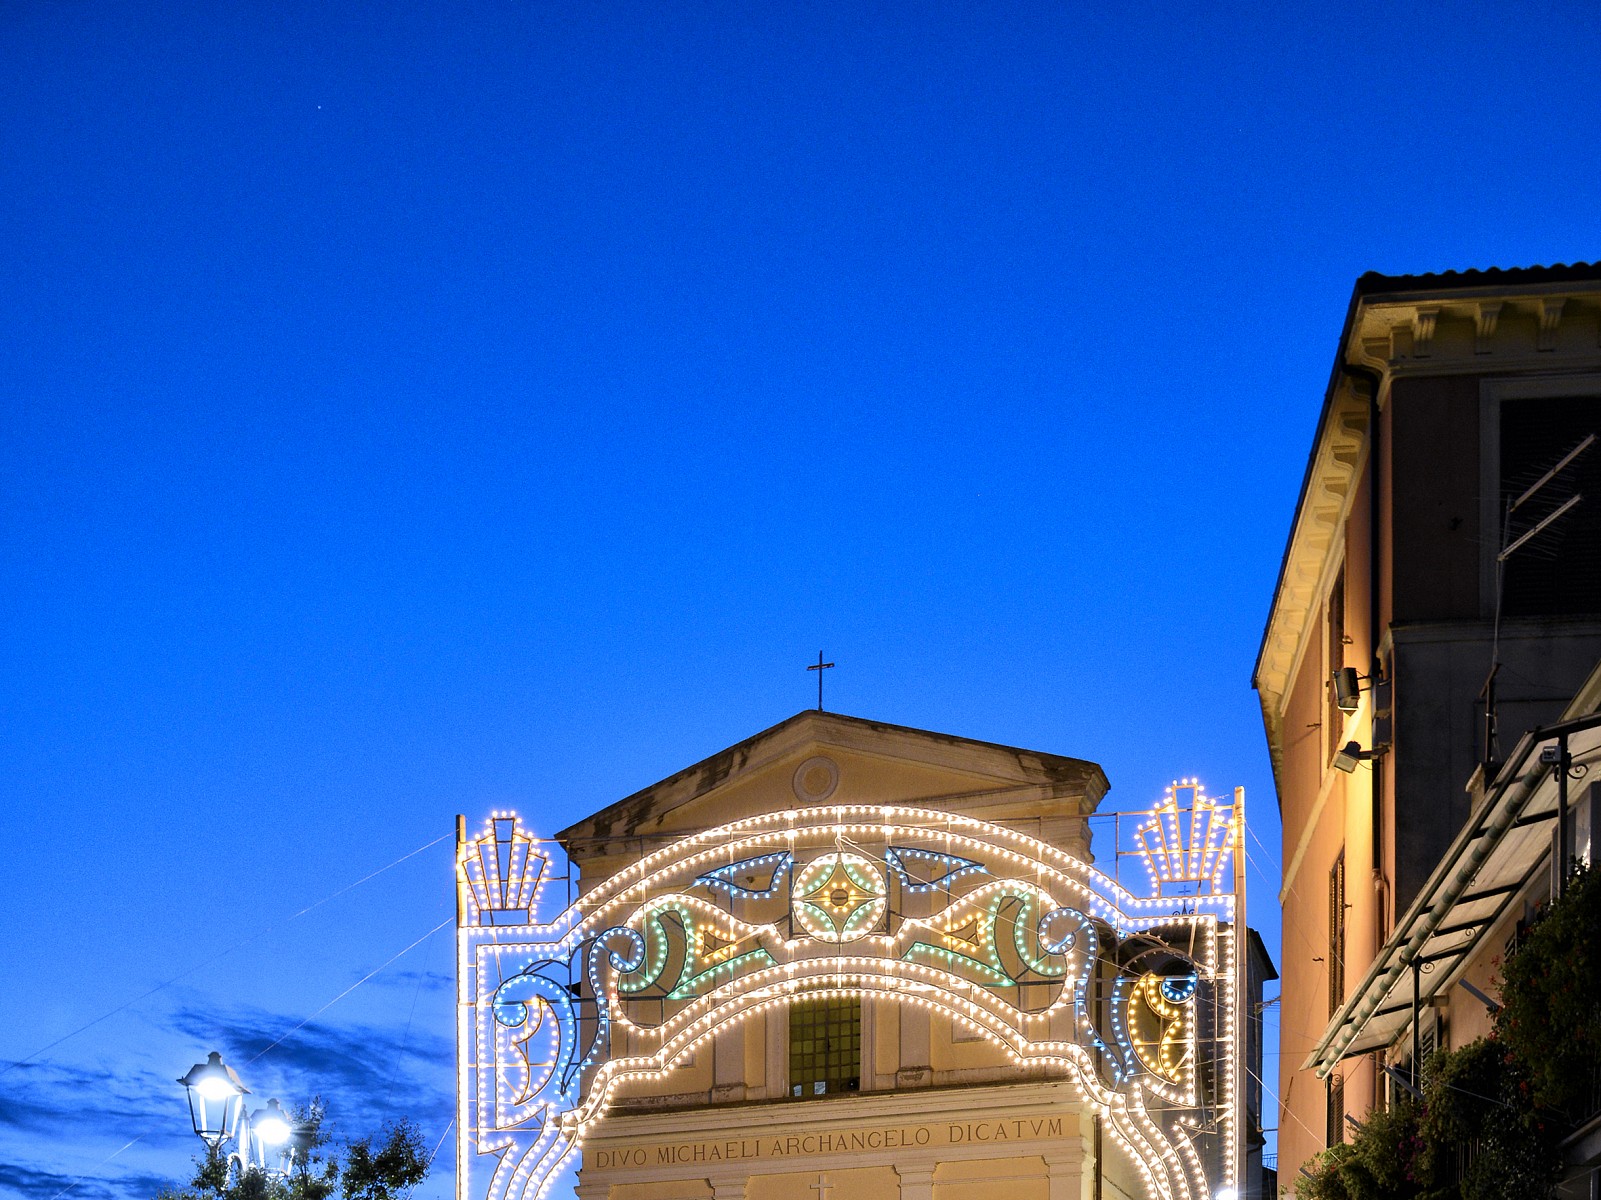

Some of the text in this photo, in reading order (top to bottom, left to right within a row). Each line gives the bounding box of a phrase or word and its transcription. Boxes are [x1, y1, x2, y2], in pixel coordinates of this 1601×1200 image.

[596, 1118, 1063, 1168] DIVO MICHAELI ARCHANGELO DICATVM
